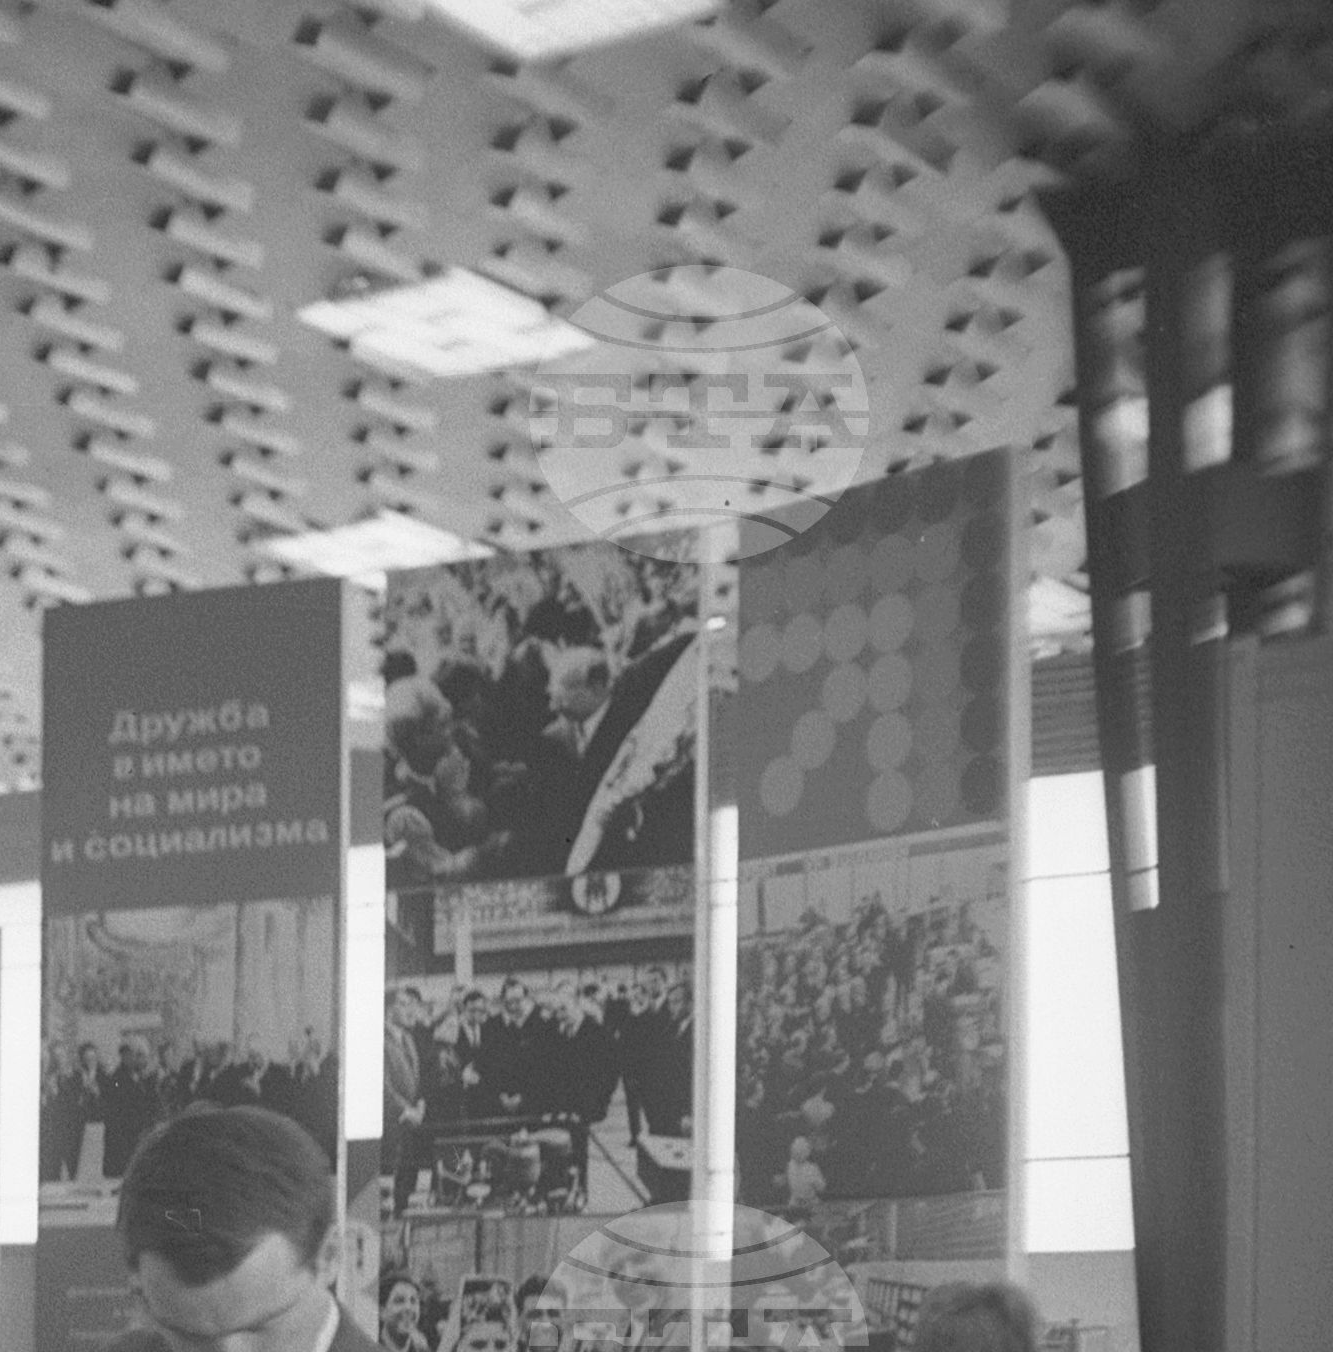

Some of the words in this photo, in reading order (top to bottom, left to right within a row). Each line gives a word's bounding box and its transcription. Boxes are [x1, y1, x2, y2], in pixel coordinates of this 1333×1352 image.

[107, 698, 271, 746] Дружба
[113, 754, 135, 780] в
[140, 744, 263, 778] името
[108, 791, 157, 818] на
[167, 781, 268, 817] мира
[50, 837, 75, 864] и
[83, 818, 329, 860] социализма
